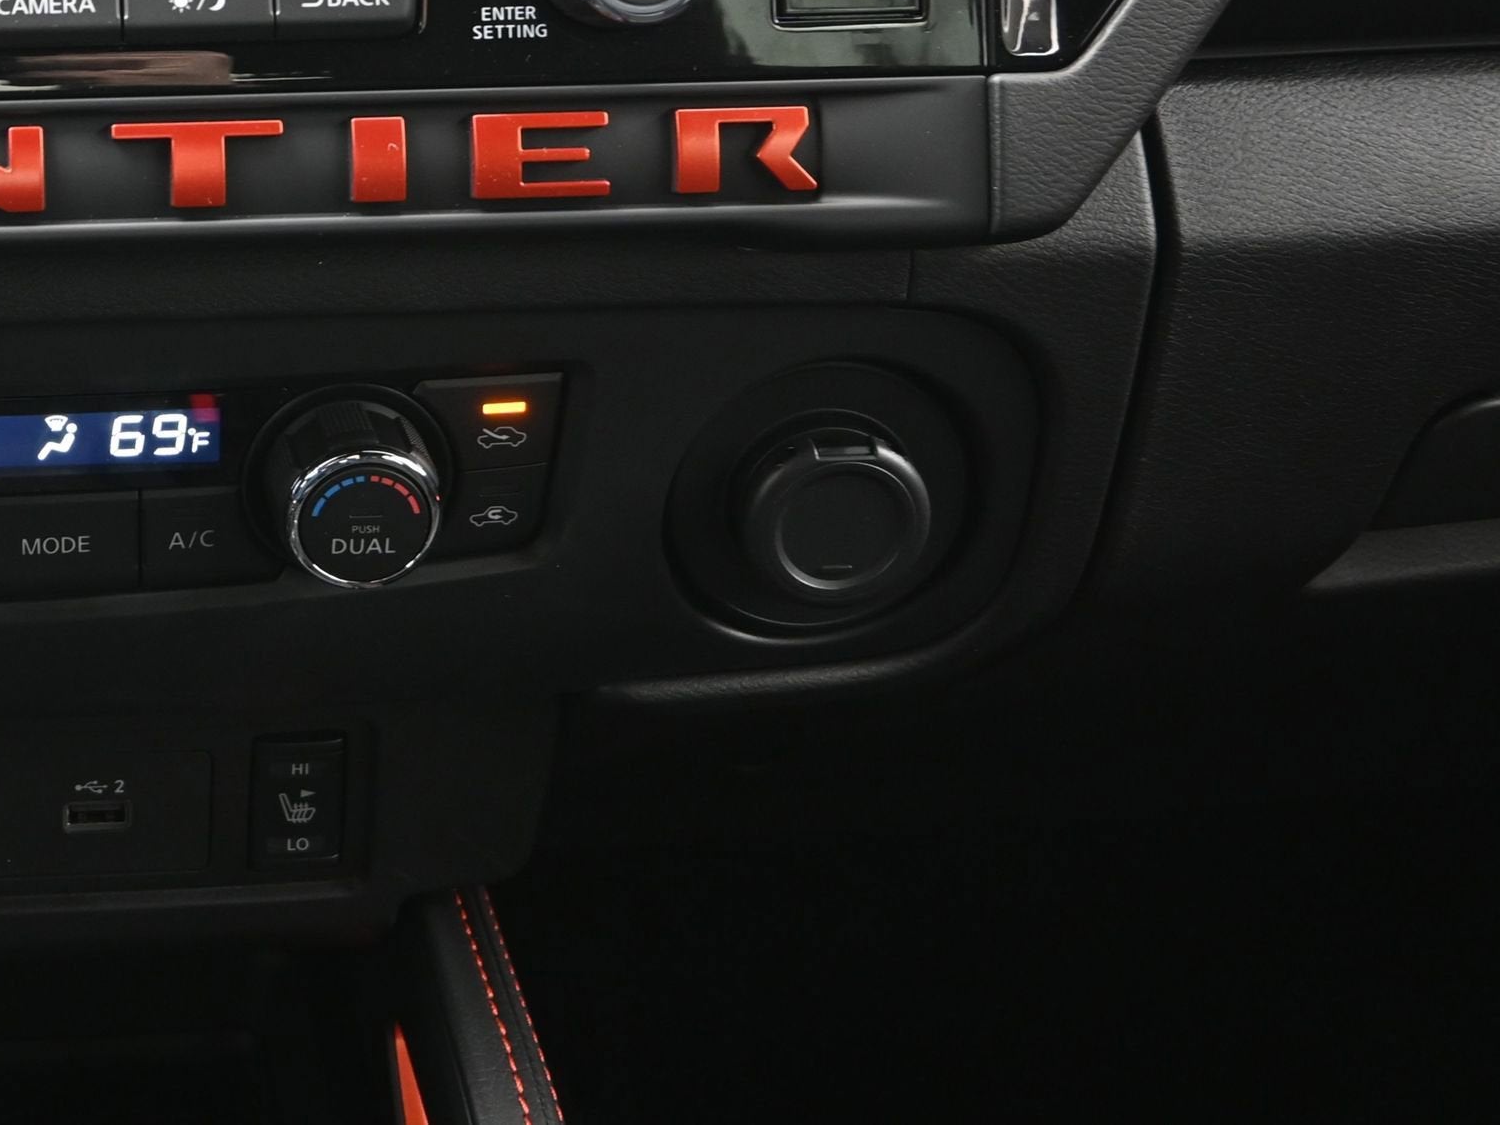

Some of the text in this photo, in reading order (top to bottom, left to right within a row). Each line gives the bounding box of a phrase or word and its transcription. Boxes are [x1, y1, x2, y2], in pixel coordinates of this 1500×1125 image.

[481, 5, 537, 22] ENTER
[472, 18, 548, 40] SETTING
[351, 524, 381, 534] PUSH
[21, 535, 90, 556] MODE
[168, 528, 216, 551] A/C
[331, 537, 396, 555] DUAL
[291, 762, 309, 775] HI
[114, 779, 125, 794] 2
[286, 837, 310, 852] LO
